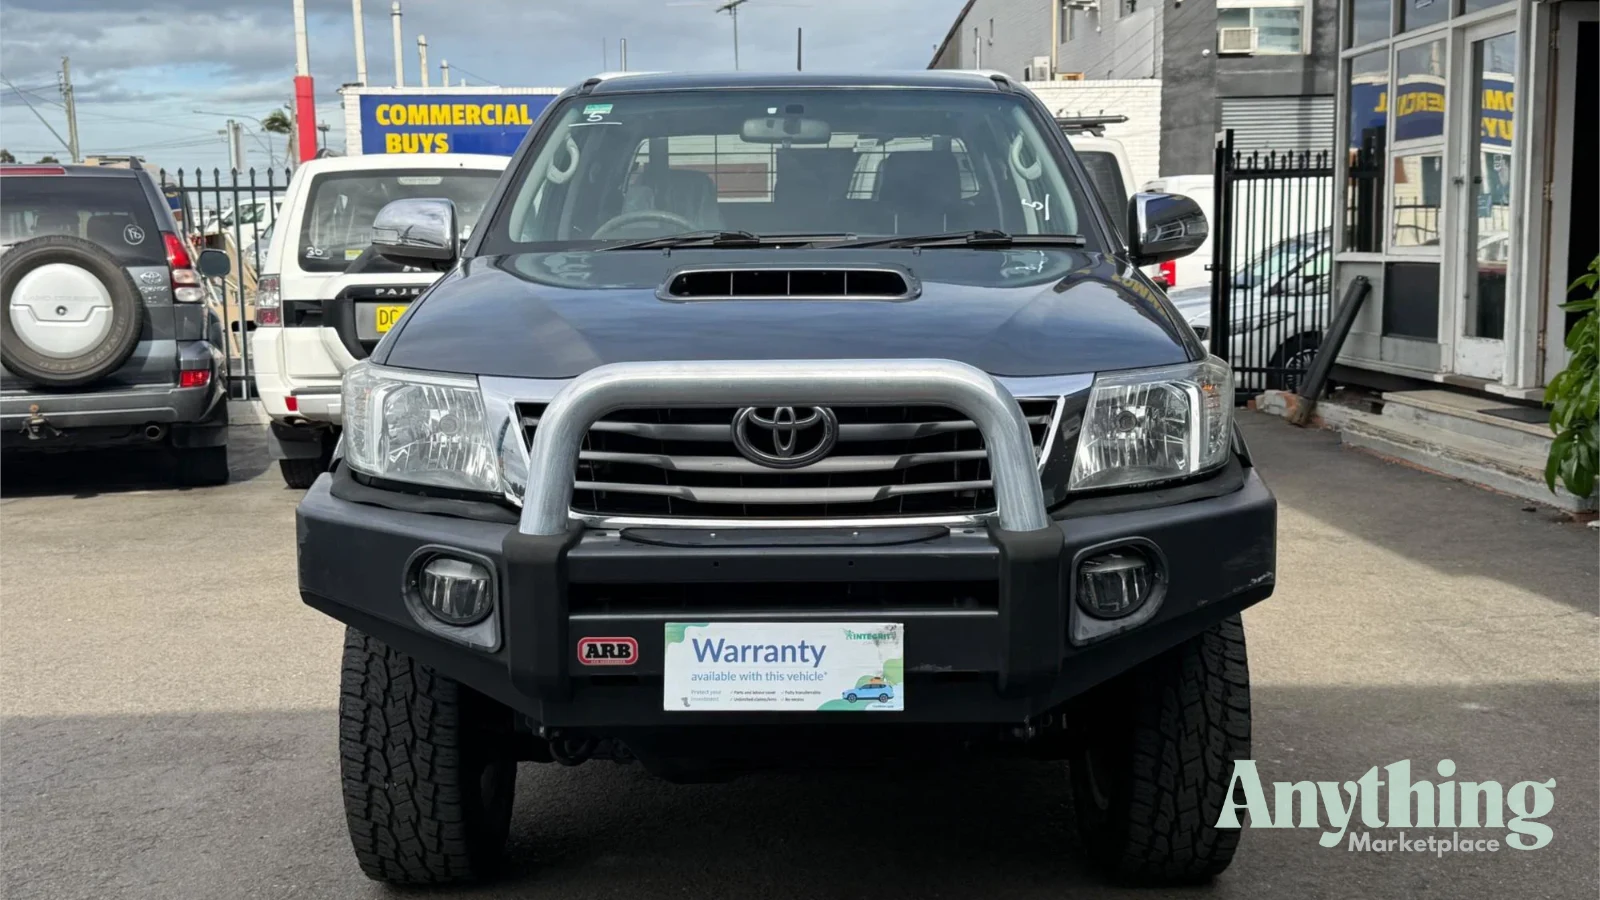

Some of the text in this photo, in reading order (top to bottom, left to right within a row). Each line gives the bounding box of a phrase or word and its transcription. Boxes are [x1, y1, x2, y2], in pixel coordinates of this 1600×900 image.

[375, 104, 533, 126] COMMERCIAL
[385, 132, 449, 154] BUYS
[375, 288, 426, 296] PAJE
[585, 643, 631, 659] ARB
[691, 638, 827, 668] Warranty
[691, 671, 736, 682] available
[739, 671, 762, 682] with
[765, 671, 784, 682] this
